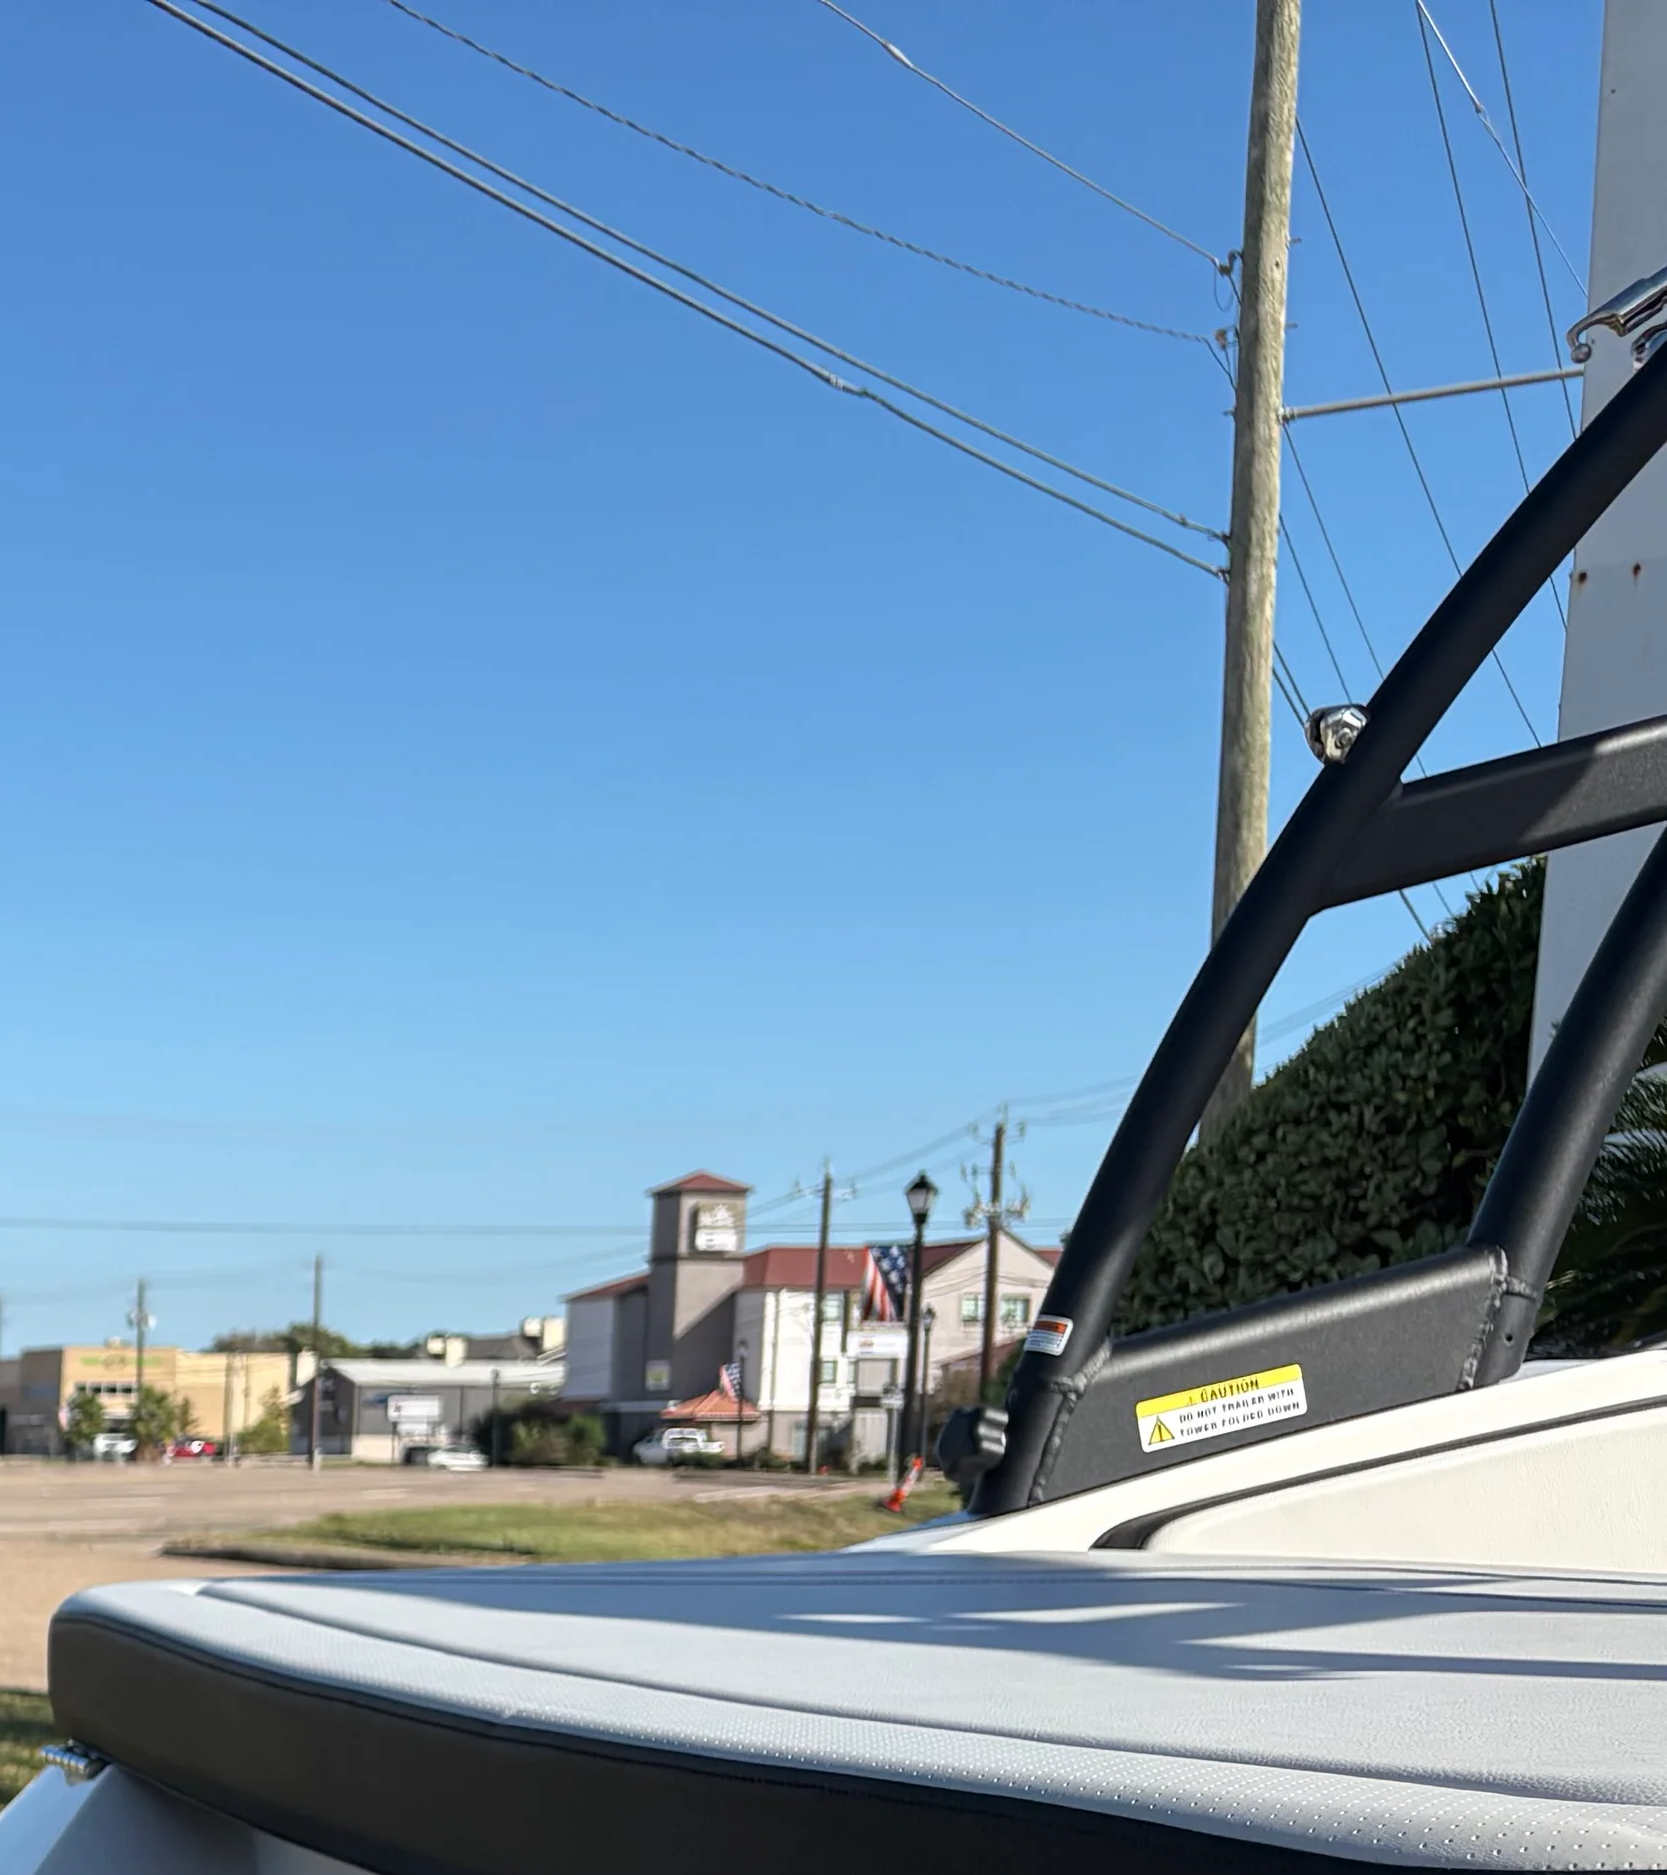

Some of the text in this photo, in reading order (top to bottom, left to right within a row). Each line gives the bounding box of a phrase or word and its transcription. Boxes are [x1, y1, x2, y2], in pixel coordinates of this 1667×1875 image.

[1179, 1388, 1294, 1423] DO NOT TRAILER WITH
[1200, 1378, 1259, 1403] CAUTION
[1180, 1401, 1300, 1437] TOWER FOLDED DOWN
